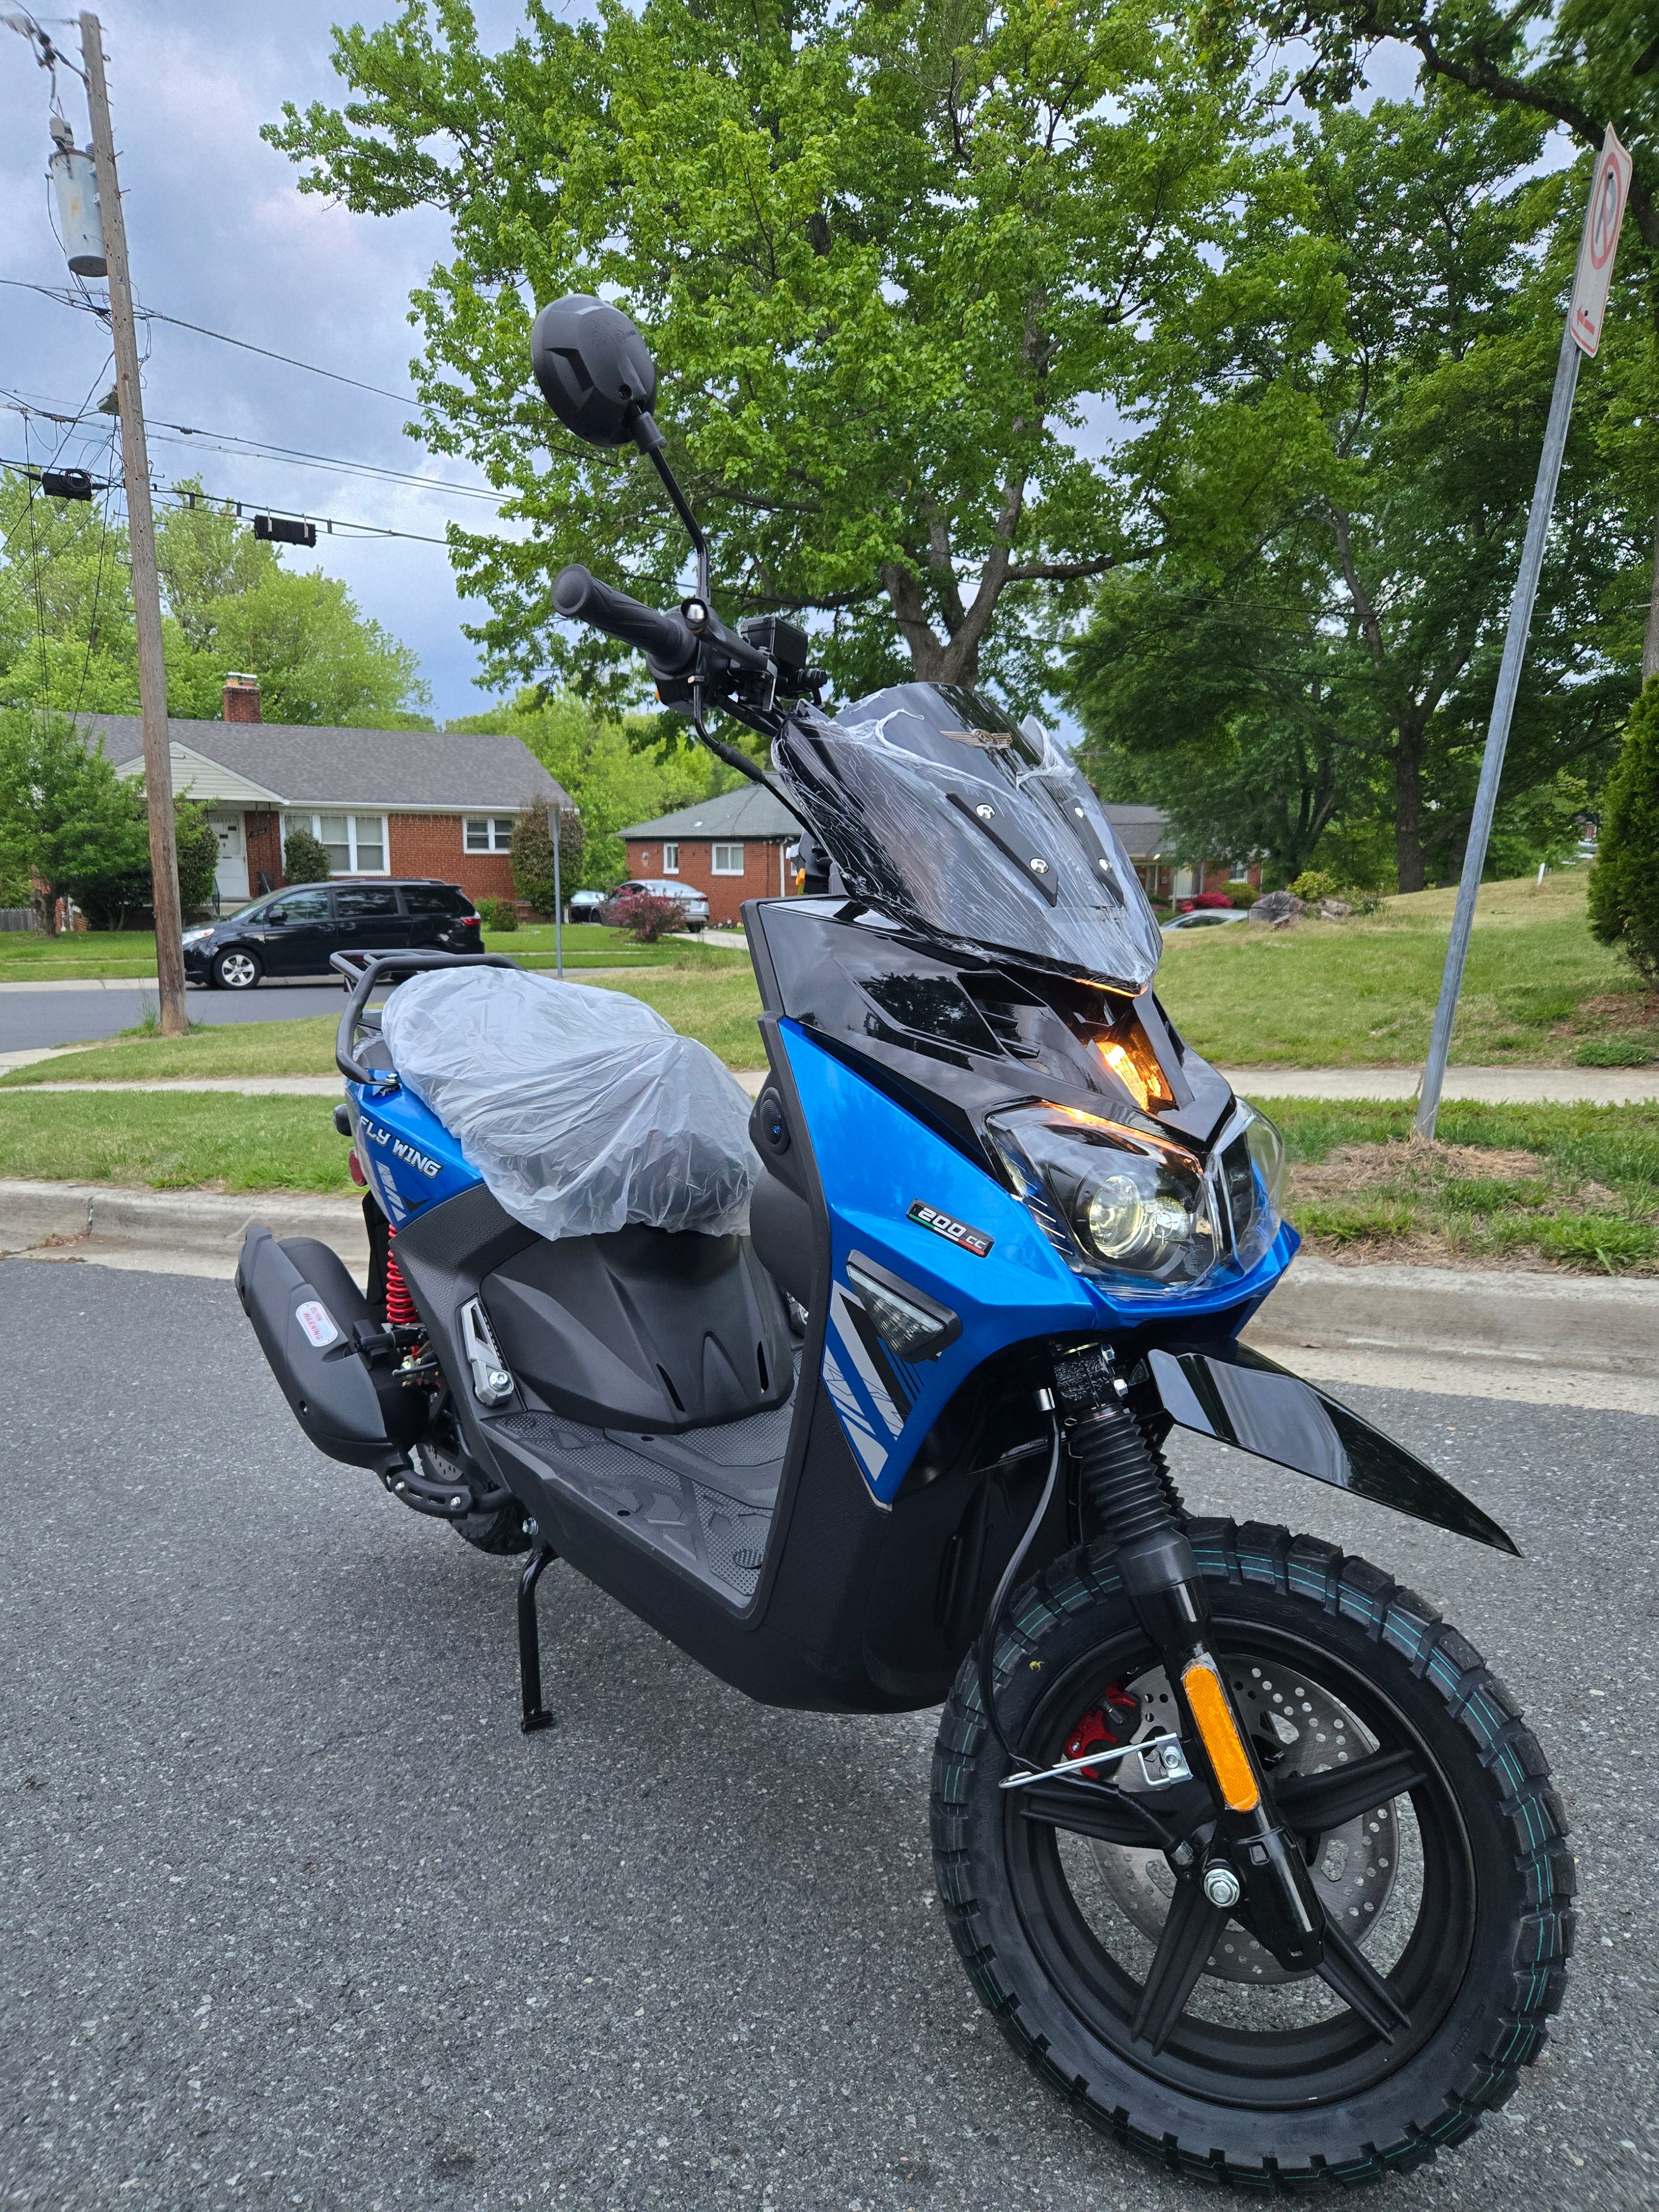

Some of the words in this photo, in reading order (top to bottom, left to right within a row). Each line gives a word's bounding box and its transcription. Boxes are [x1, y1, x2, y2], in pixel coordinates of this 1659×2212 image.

[359, 1115, 391, 1146] FLY
[392, 1139, 442, 1178] WING
[918, 1207, 966, 1238] 200
[303, 1312, 323, 1339] WARNING
[310, 1307, 323, 1321] BURN
